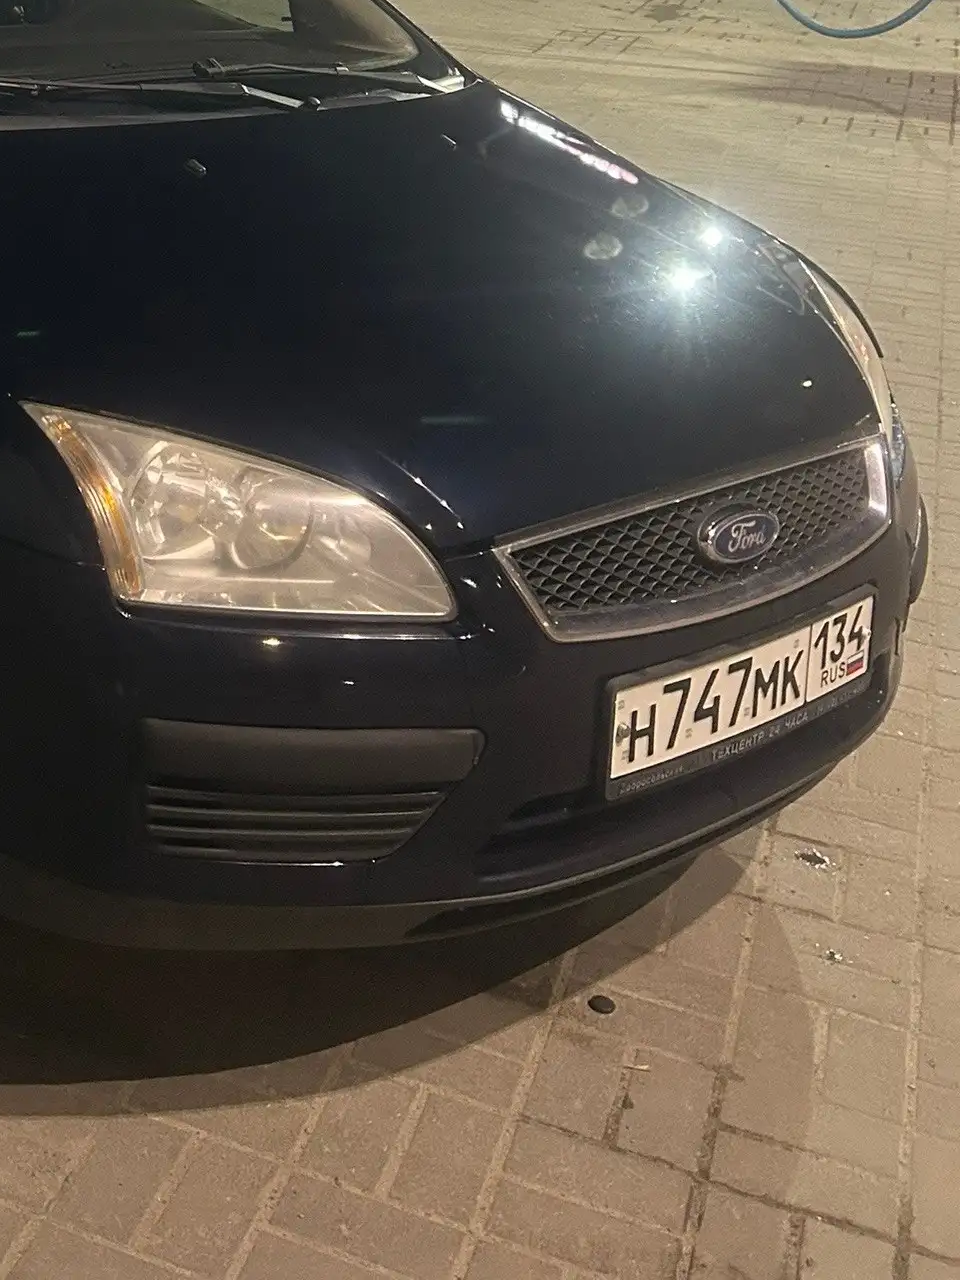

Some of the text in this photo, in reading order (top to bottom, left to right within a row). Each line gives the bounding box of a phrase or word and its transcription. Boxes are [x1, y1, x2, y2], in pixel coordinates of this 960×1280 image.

[727, 519, 766, 553] Ford
[627, 605, 868, 764] Н747МК 134
[820, 660, 846, 689] RUS
